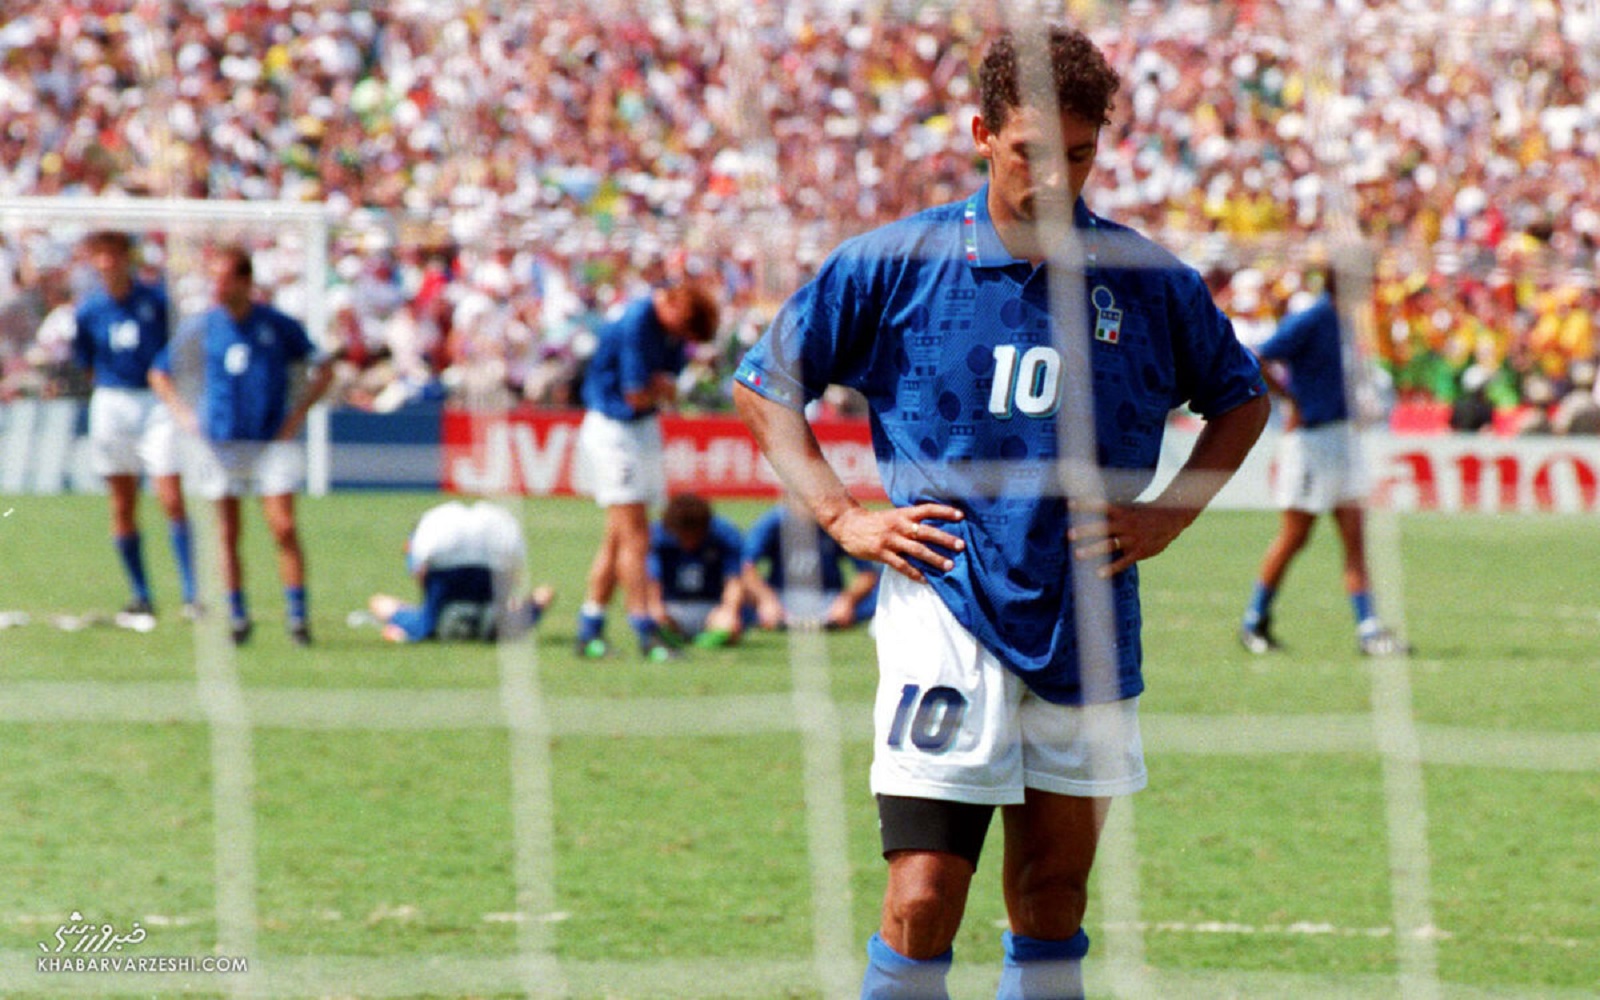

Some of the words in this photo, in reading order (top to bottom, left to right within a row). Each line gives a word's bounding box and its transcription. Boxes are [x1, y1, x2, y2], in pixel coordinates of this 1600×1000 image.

[988, 345, 1063, 419] 10
[452, 421, 594, 495] JV
[1368, 451, 1598, 511] ano
[887, 684, 967, 755] 10
